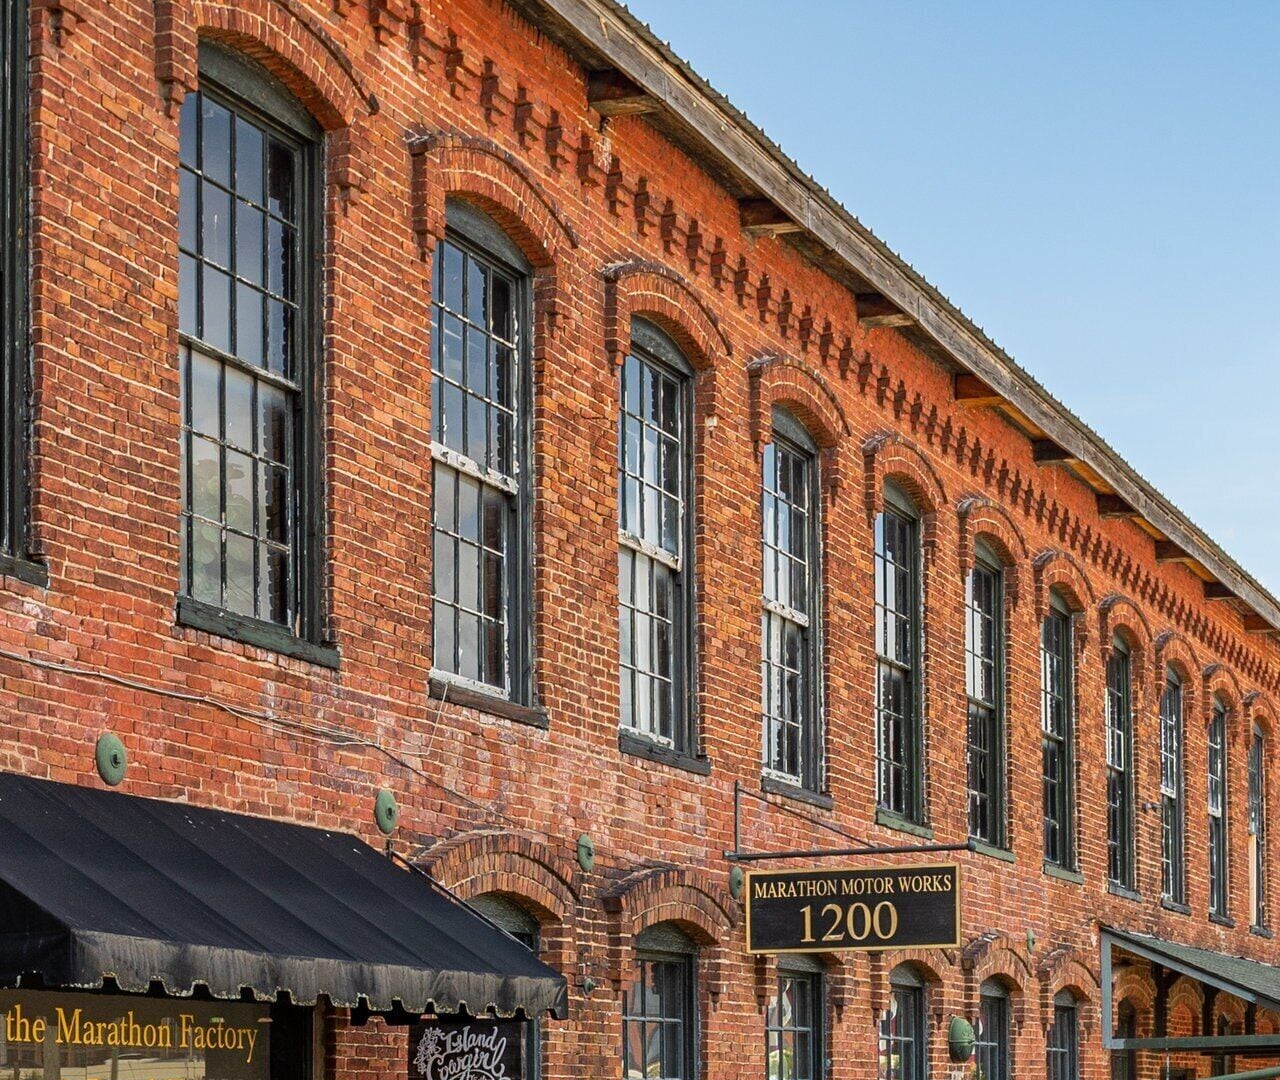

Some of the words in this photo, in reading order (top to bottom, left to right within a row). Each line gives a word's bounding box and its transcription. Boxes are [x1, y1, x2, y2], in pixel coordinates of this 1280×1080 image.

[754, 879, 838, 899] MARATHON
[841, 877, 895, 896] MOTOR
[898, 874, 952, 893] WORKS
[799, 901, 898, 943] 1200
[6, 1004, 46, 1043] the
[56, 1007, 172, 1048] Marathon
[179, 1014, 258, 1063] Factory
[441, 1025, 498, 1054] Island
